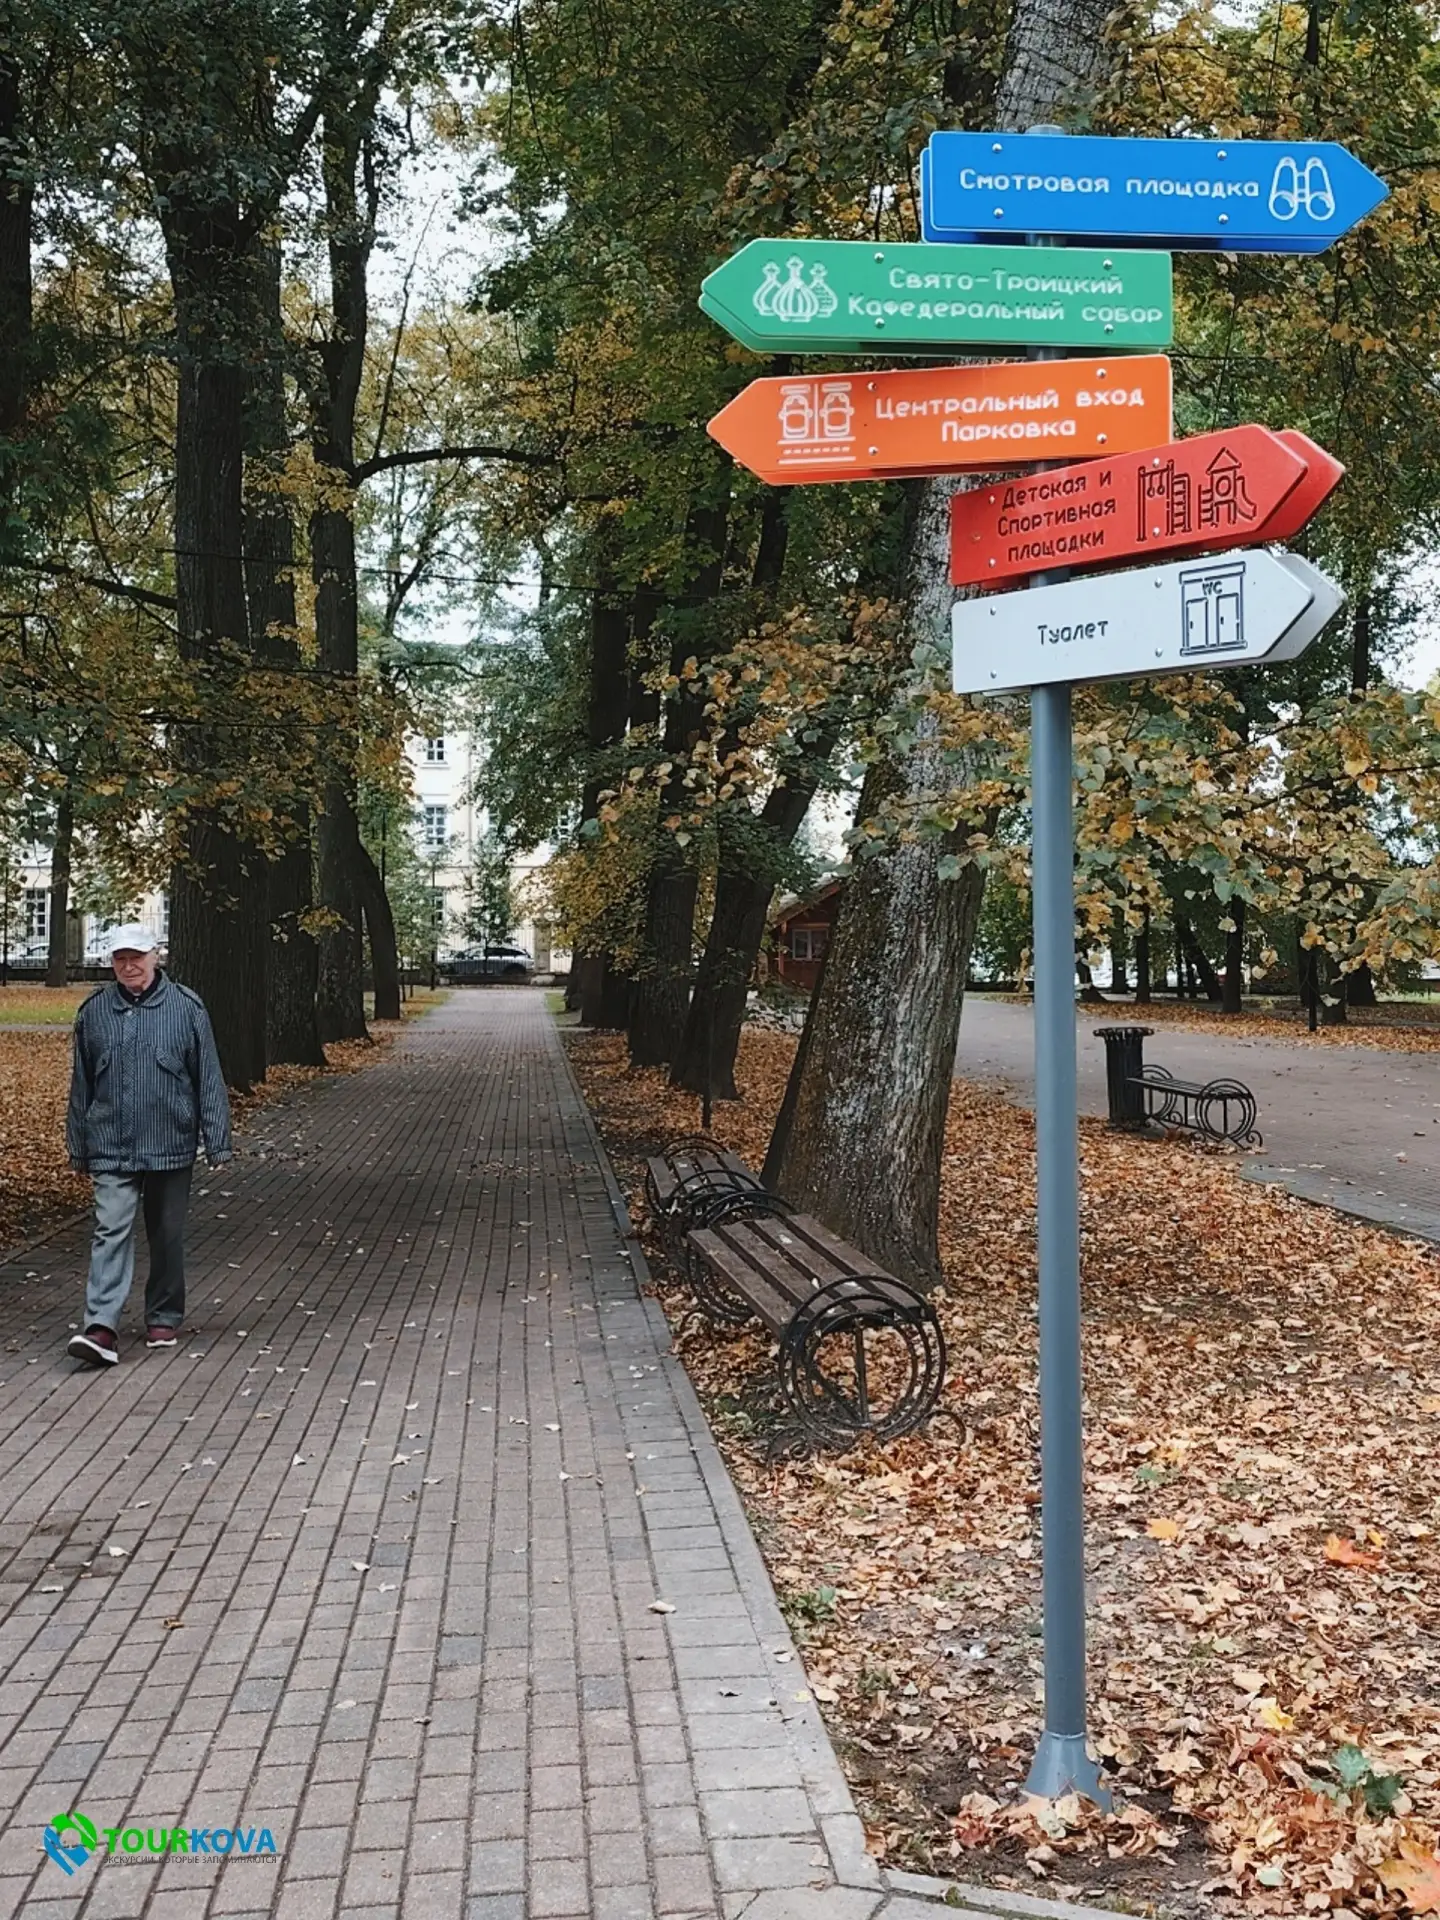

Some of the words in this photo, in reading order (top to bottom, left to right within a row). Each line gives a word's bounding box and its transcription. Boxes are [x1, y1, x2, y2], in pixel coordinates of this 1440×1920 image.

[960, 168, 1110, 194] Смотровая
[1126, 177, 1259, 199] площадка
[889, 267, 1123, 296] Свято-Троицкий
[848, 297, 1064, 320] Кафедеральный
[1082, 306, 1163, 324] собор
[876, 389, 1059, 419] Центральный
[1076, 387, 1145, 407] вход
[942, 420, 1076, 442] Парковка
[1002, 476, 1086, 511] Детская
[1099, 471, 1112, 489] и
[998, 497, 1117, 537] Спортивная
[1008, 530, 1105, 563] площадки
[1202, 579, 1223, 596] WC
[1037, 620, 1109, 646] Туалет
